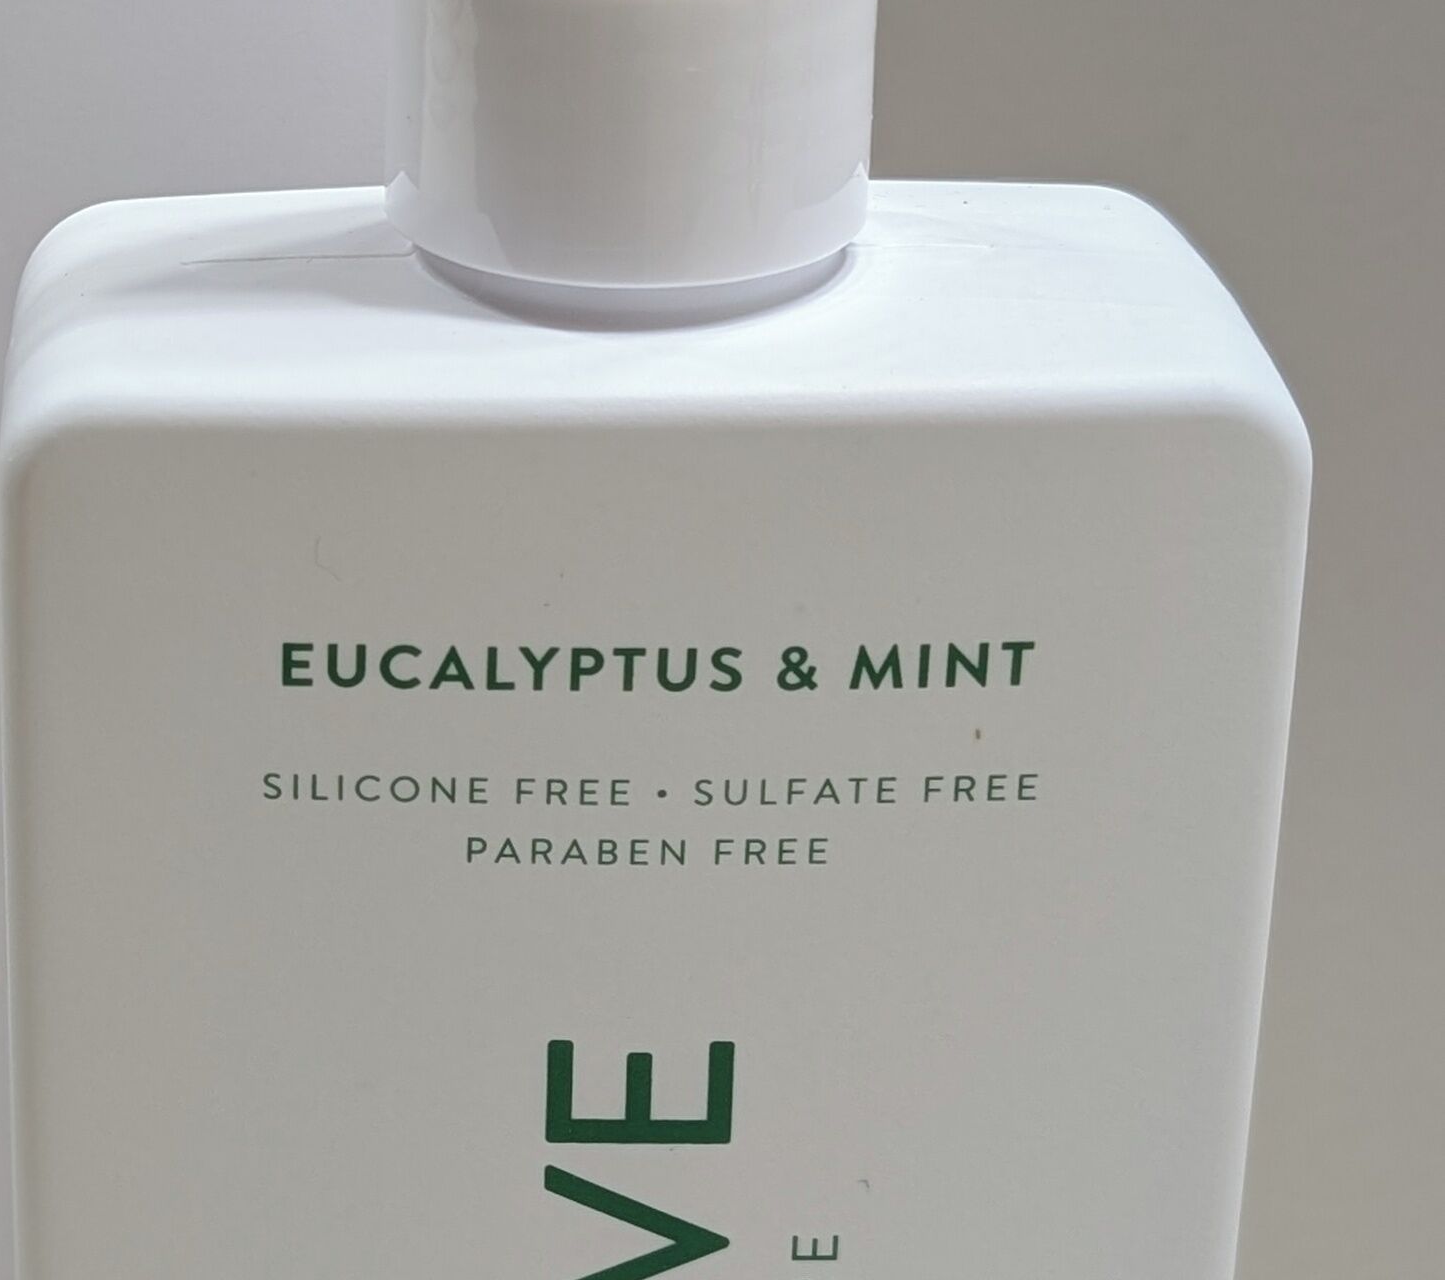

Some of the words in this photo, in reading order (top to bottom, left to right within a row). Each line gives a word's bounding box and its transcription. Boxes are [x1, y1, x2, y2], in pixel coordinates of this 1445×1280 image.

[281, 642, 743, 693] EUCALYPTUS
[776, 645, 818, 692] &
[848, 640, 1036, 690] MINT
[262, 772, 489, 805] SILICONE
[515, 777, 631, 807] FREE
[693, 776, 897, 807] SULFATE
[923, 773, 1039, 803] FREE
[466, 836, 686, 866] PARABEN
[714, 837, 829, 866] FREE
